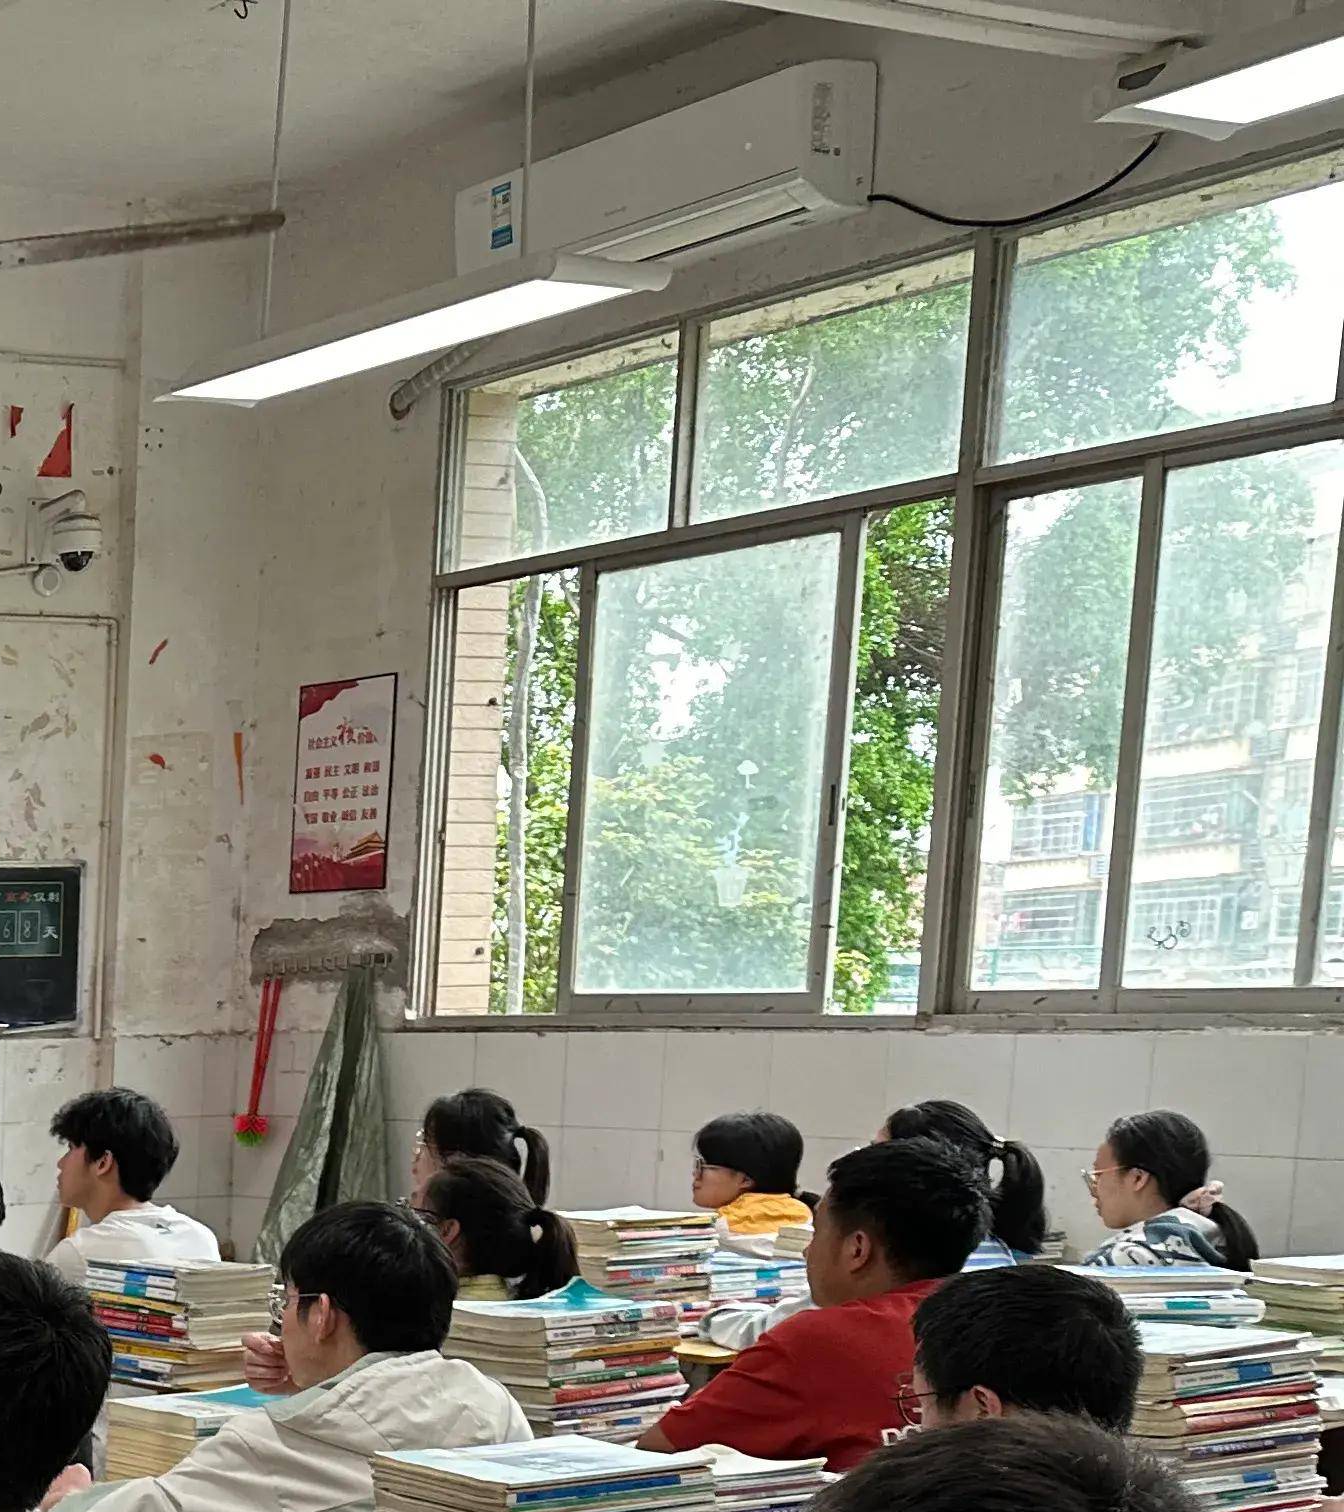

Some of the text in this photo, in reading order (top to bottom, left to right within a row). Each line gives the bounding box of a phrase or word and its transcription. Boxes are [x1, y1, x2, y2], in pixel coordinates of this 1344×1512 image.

[3, 919, 32, 939] 6 8
[43, 926, 59, 940] 天
